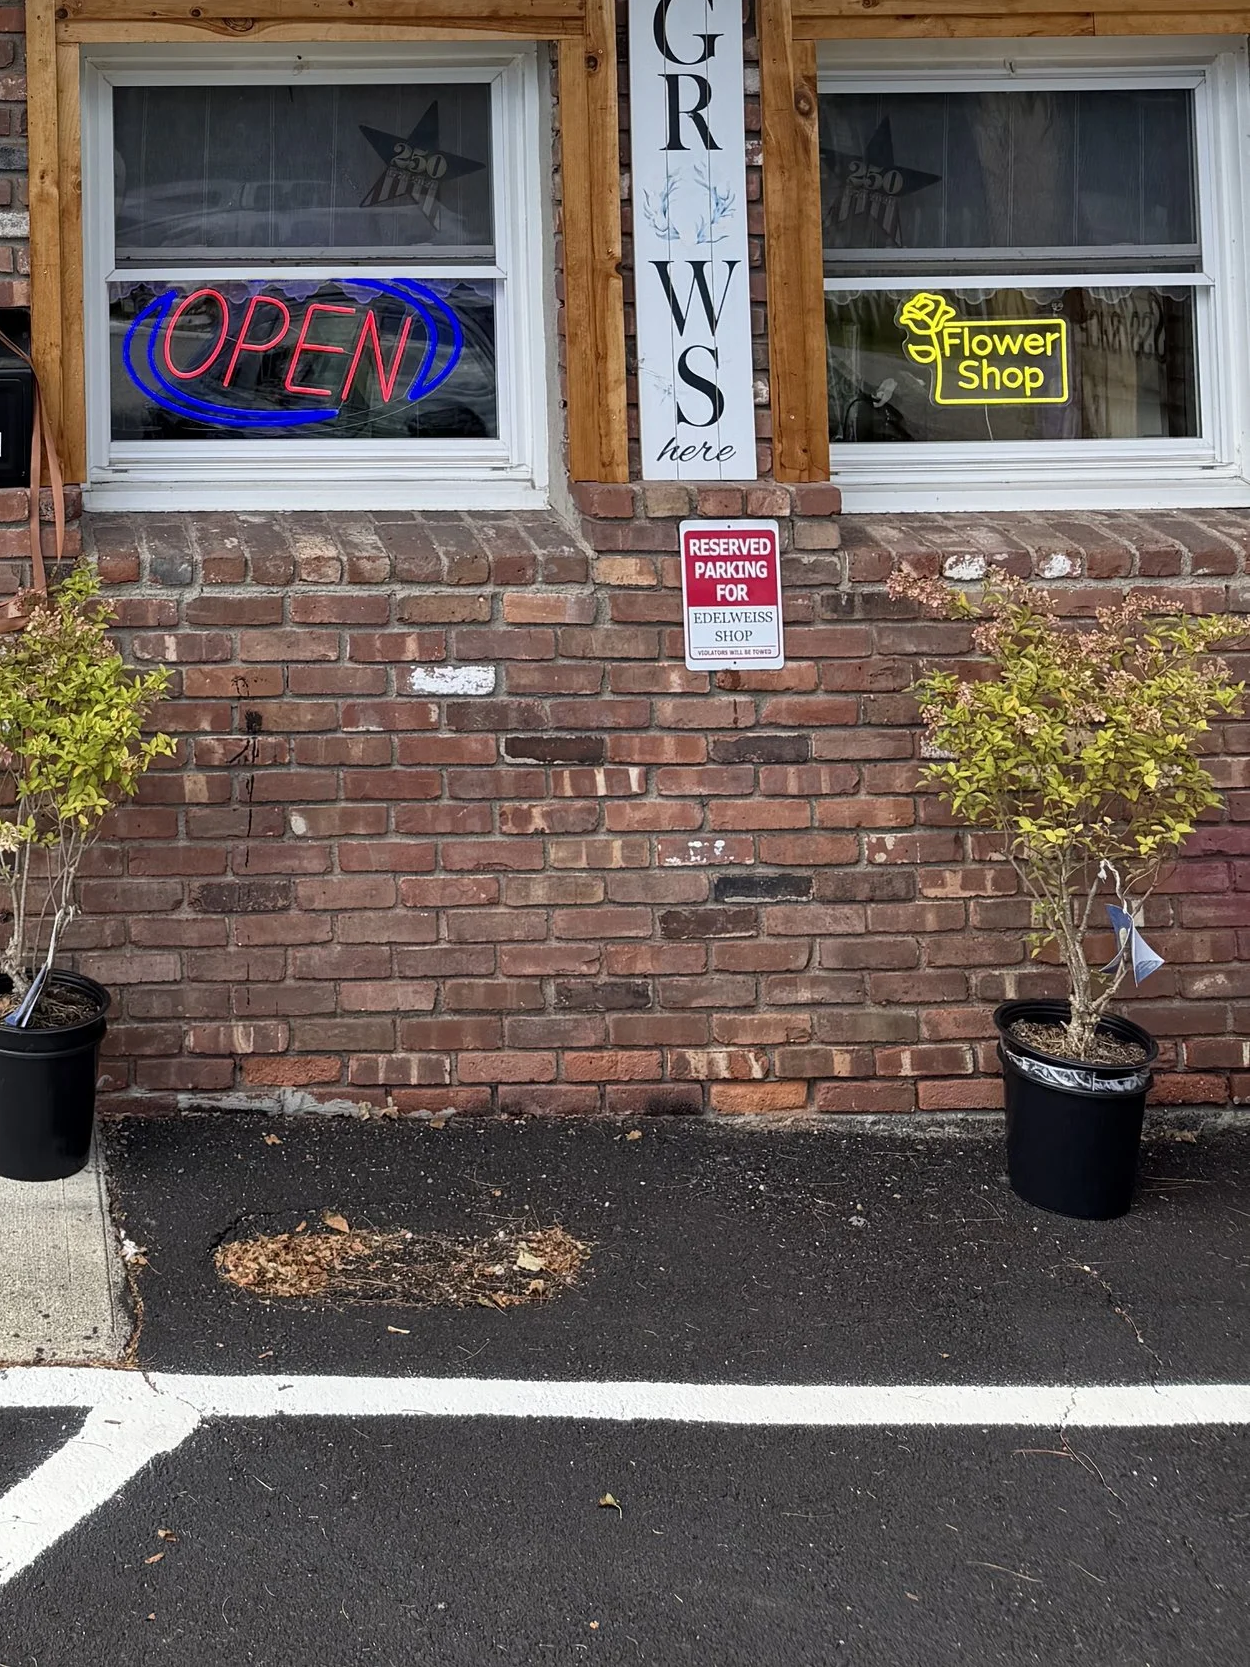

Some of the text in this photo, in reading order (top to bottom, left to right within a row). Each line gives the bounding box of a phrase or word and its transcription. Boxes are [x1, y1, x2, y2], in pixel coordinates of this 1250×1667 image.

[390, 142, 448, 180] 250
[846, 160, 904, 195] 250
[162, 286, 413, 404] OPEN
[942, 326, 1061, 358] Flower
[957, 358, 1046, 398] Shop
[656, 436, 737, 463] here
[688, 537, 772, 557] RESERVED
[694, 560, 768, 579] PARKING
[716, 584, 749, 602] FOR
[693, 611, 773, 624] EDELWEISS
[714, 630, 753, 642] SHOP
